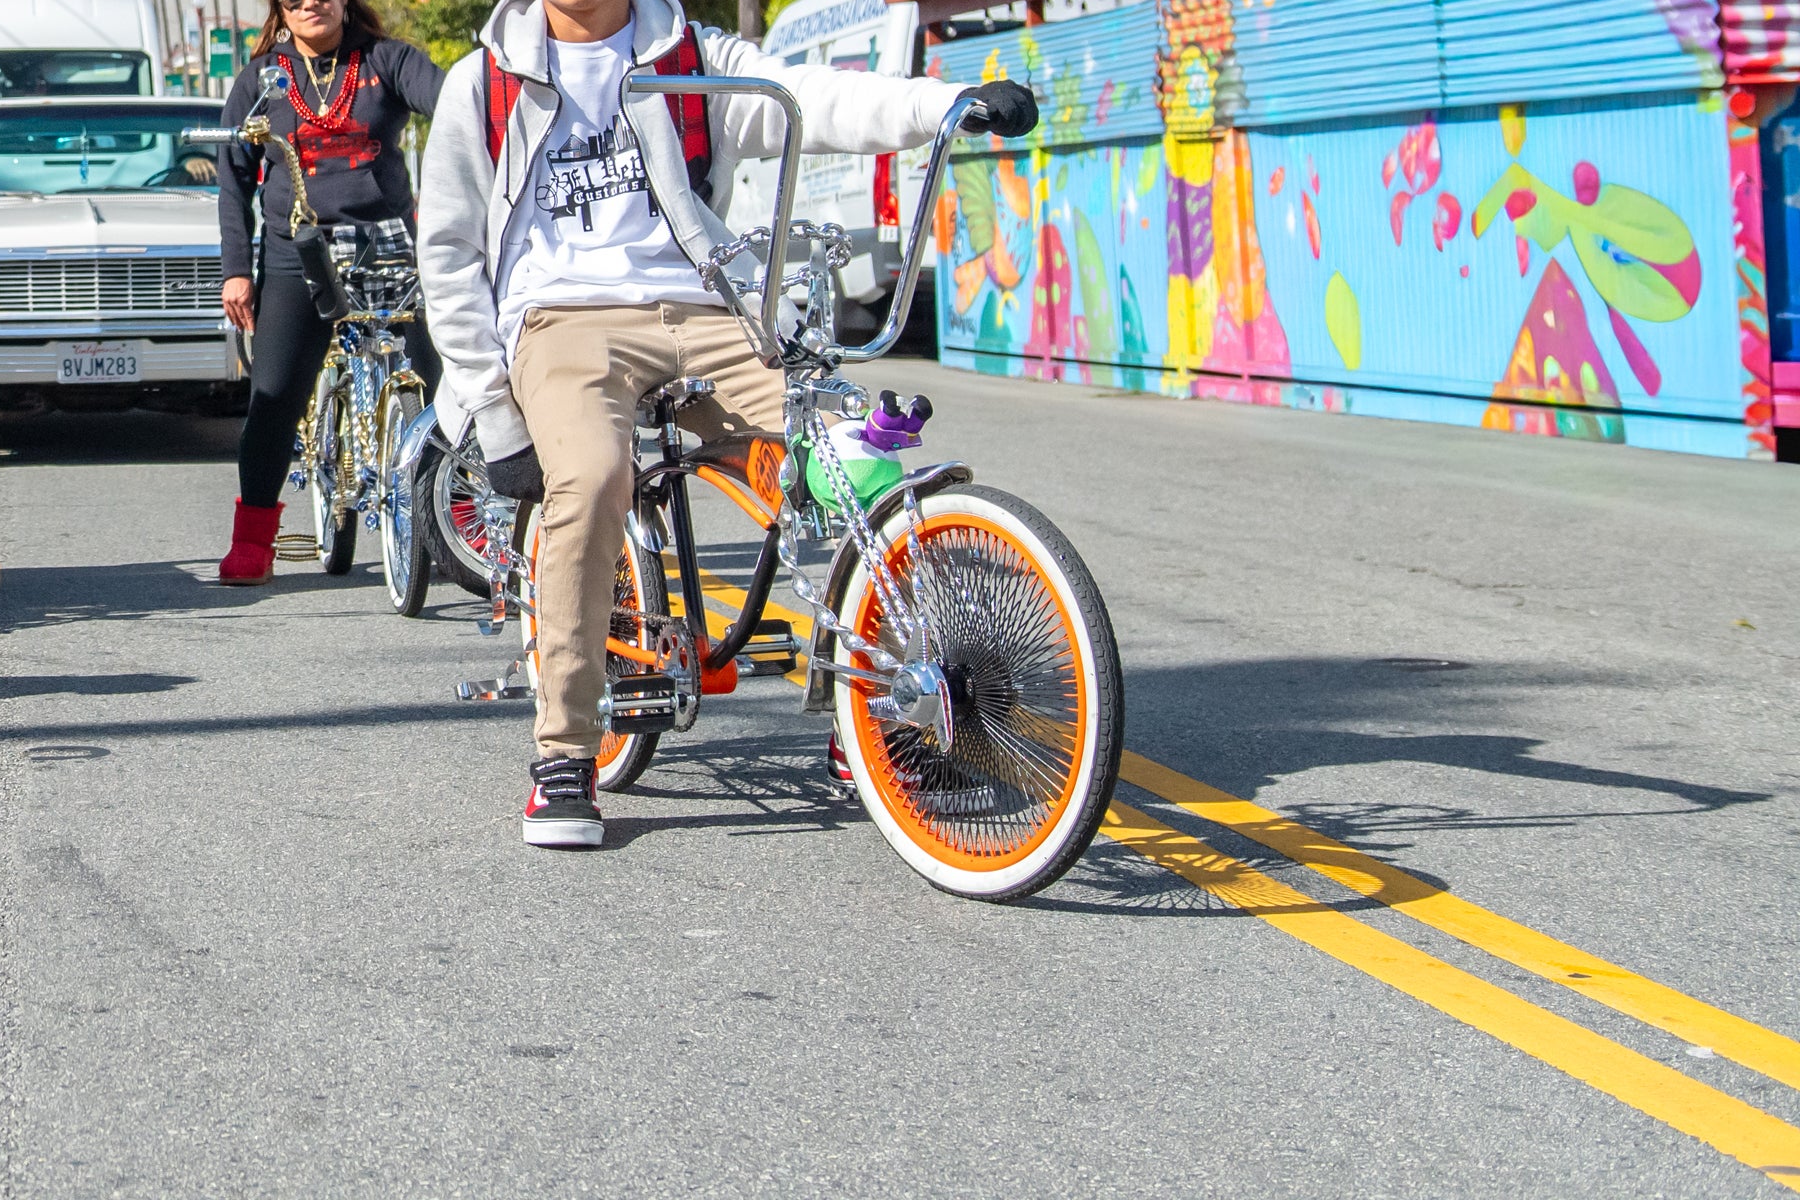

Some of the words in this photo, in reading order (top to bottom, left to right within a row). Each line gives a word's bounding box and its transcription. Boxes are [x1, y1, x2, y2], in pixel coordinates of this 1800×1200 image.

[561, 162, 596, 192] El
[573, 180, 640, 205] Customs
[75, 344, 125, 356] California
[63, 356, 137, 378] 8VJM283
